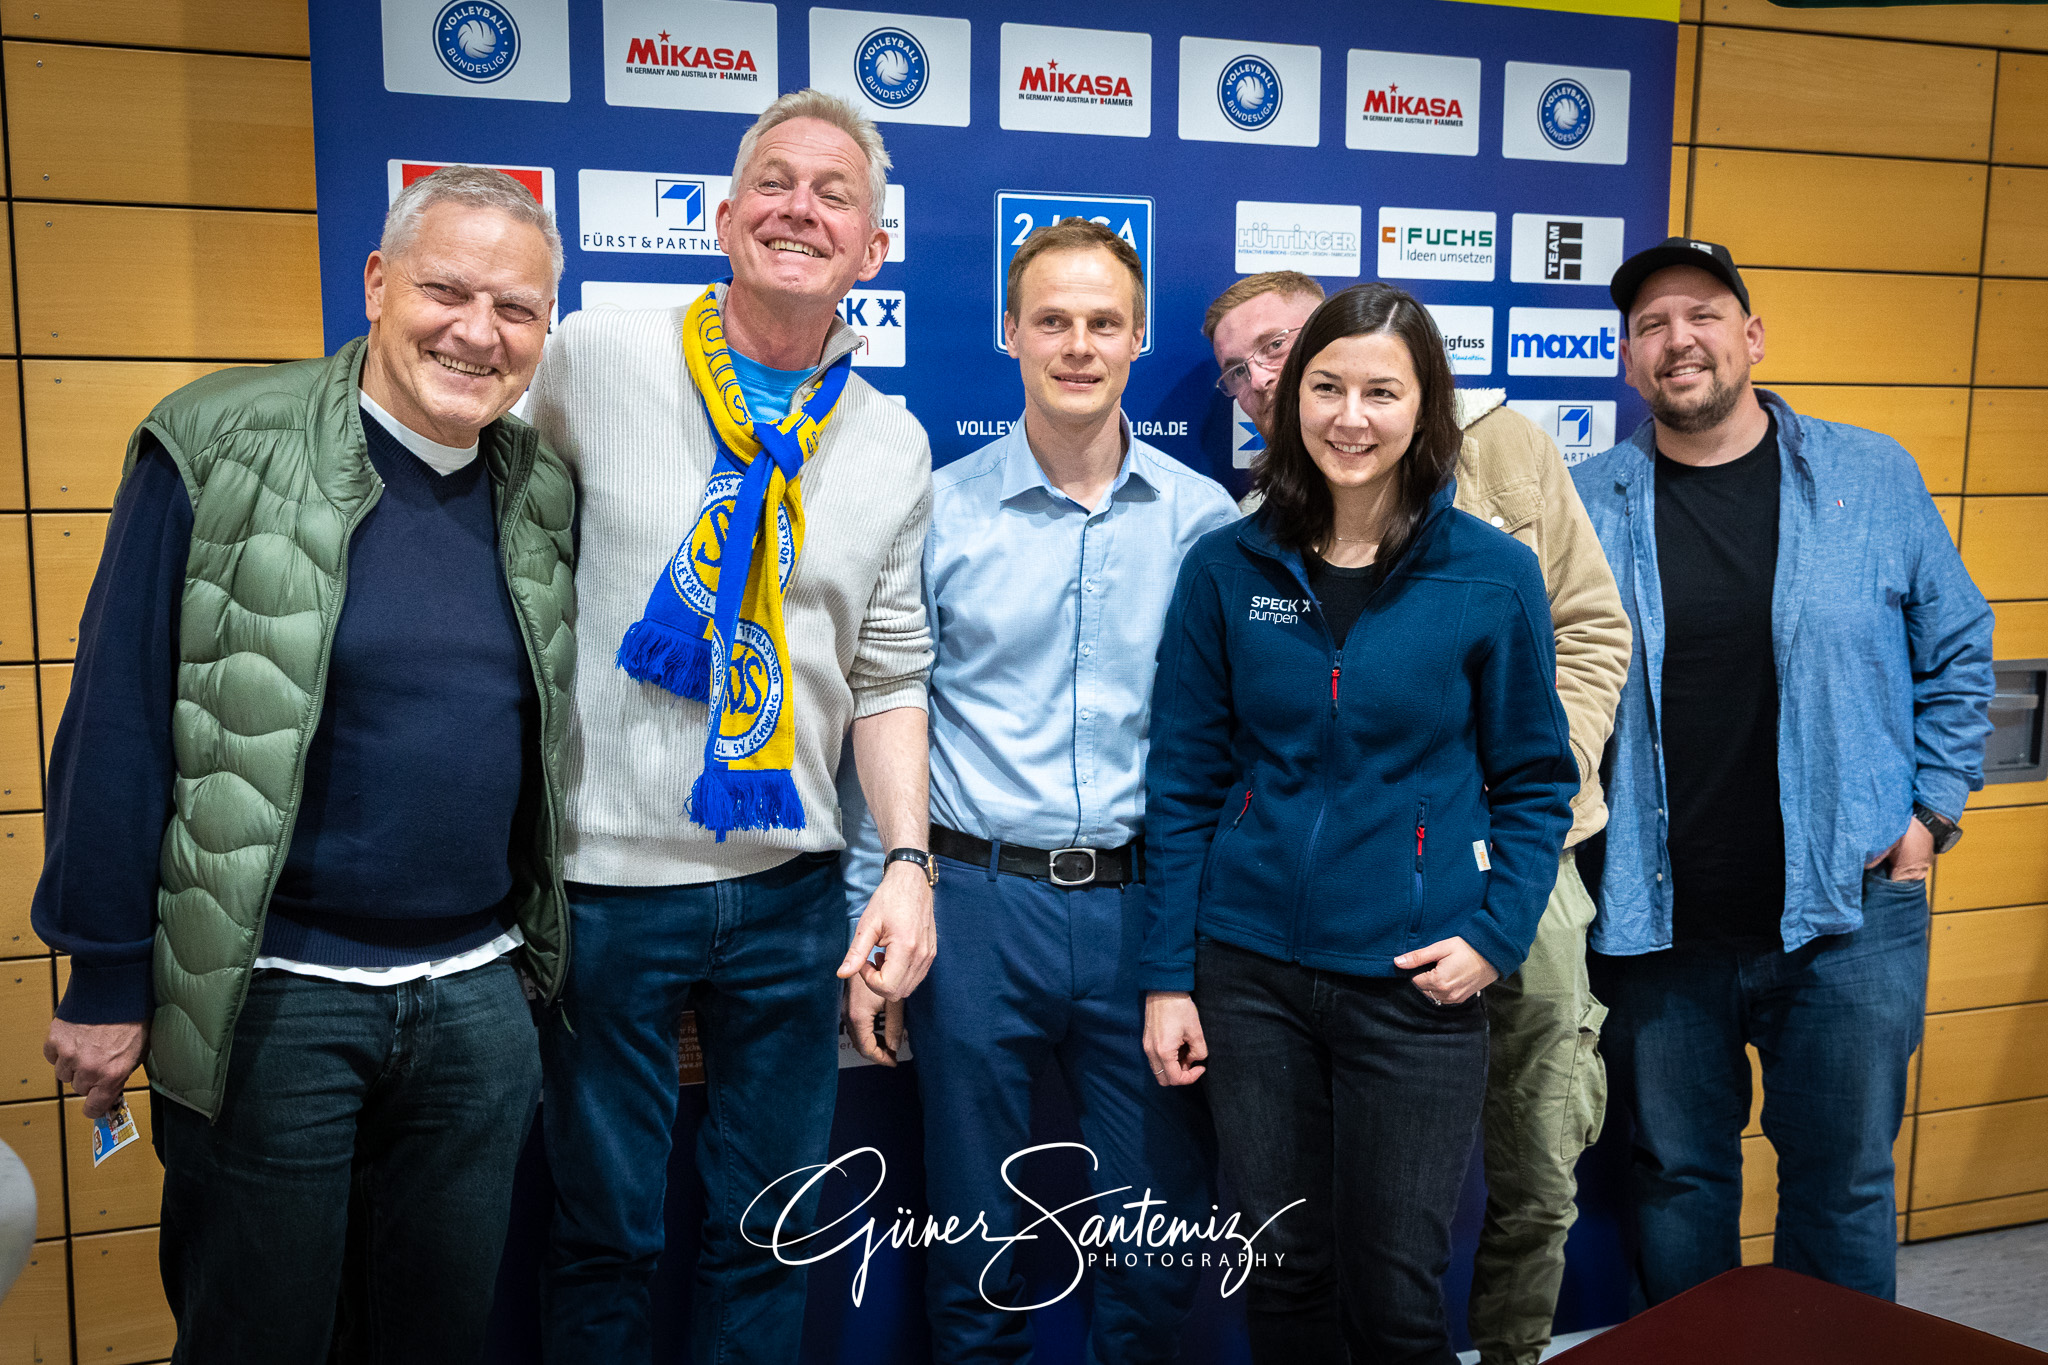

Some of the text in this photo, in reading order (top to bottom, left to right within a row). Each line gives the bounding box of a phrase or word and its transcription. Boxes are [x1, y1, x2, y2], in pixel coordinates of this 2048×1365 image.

[444, 6, 507, 34] VOLLEYBALL
[447, 48, 508, 73] BUNDESLIGA
[626, 38, 757, 72] MIKASA
[864, 37, 918, 63] VOLLEYBALL
[635, 67, 665, 76] GERMANY
[667, 69, 680, 77] AND
[681, 70, 708, 78] AUSTRIA
[720, 72, 757, 81] HAMMER
[1019, 66, 1132, 97] MIKASA
[1226, 64, 1273, 89] VOLLEYBALL
[866, 76, 919, 99] BUNDESLIGA
[1545, 87, 1587, 110] VOLLEYBALL
[1026, 94, 1052, 102] GERMANY
[1066, 96, 1089, 104] AUSTRIA
[1100, 98, 1133, 106] HAMMER
[1227, 100, 1273, 122] BUNDESLIGA
[1363, 89, 1463, 118] MIKASA
[1545, 121, 1586, 142] BUNDESLIGA
[583, 232, 720, 250] FÜRST & PARTNE
[1237, 222, 1356, 251] HÜTTINGER
[1408, 227, 1493, 247] FUCHS
[1407, 249, 1493, 264] Ideen umsetzen
[1547, 225, 1560, 276] TEAM
[1444, 335, 1485, 351] igfuss
[1510, 327, 1616, 360] maxit
[1250, 595, 1299, 613] SPECK
[1249, 609, 1299, 625] pumpen
[748, 693, 779, 749] SCHWAIG
